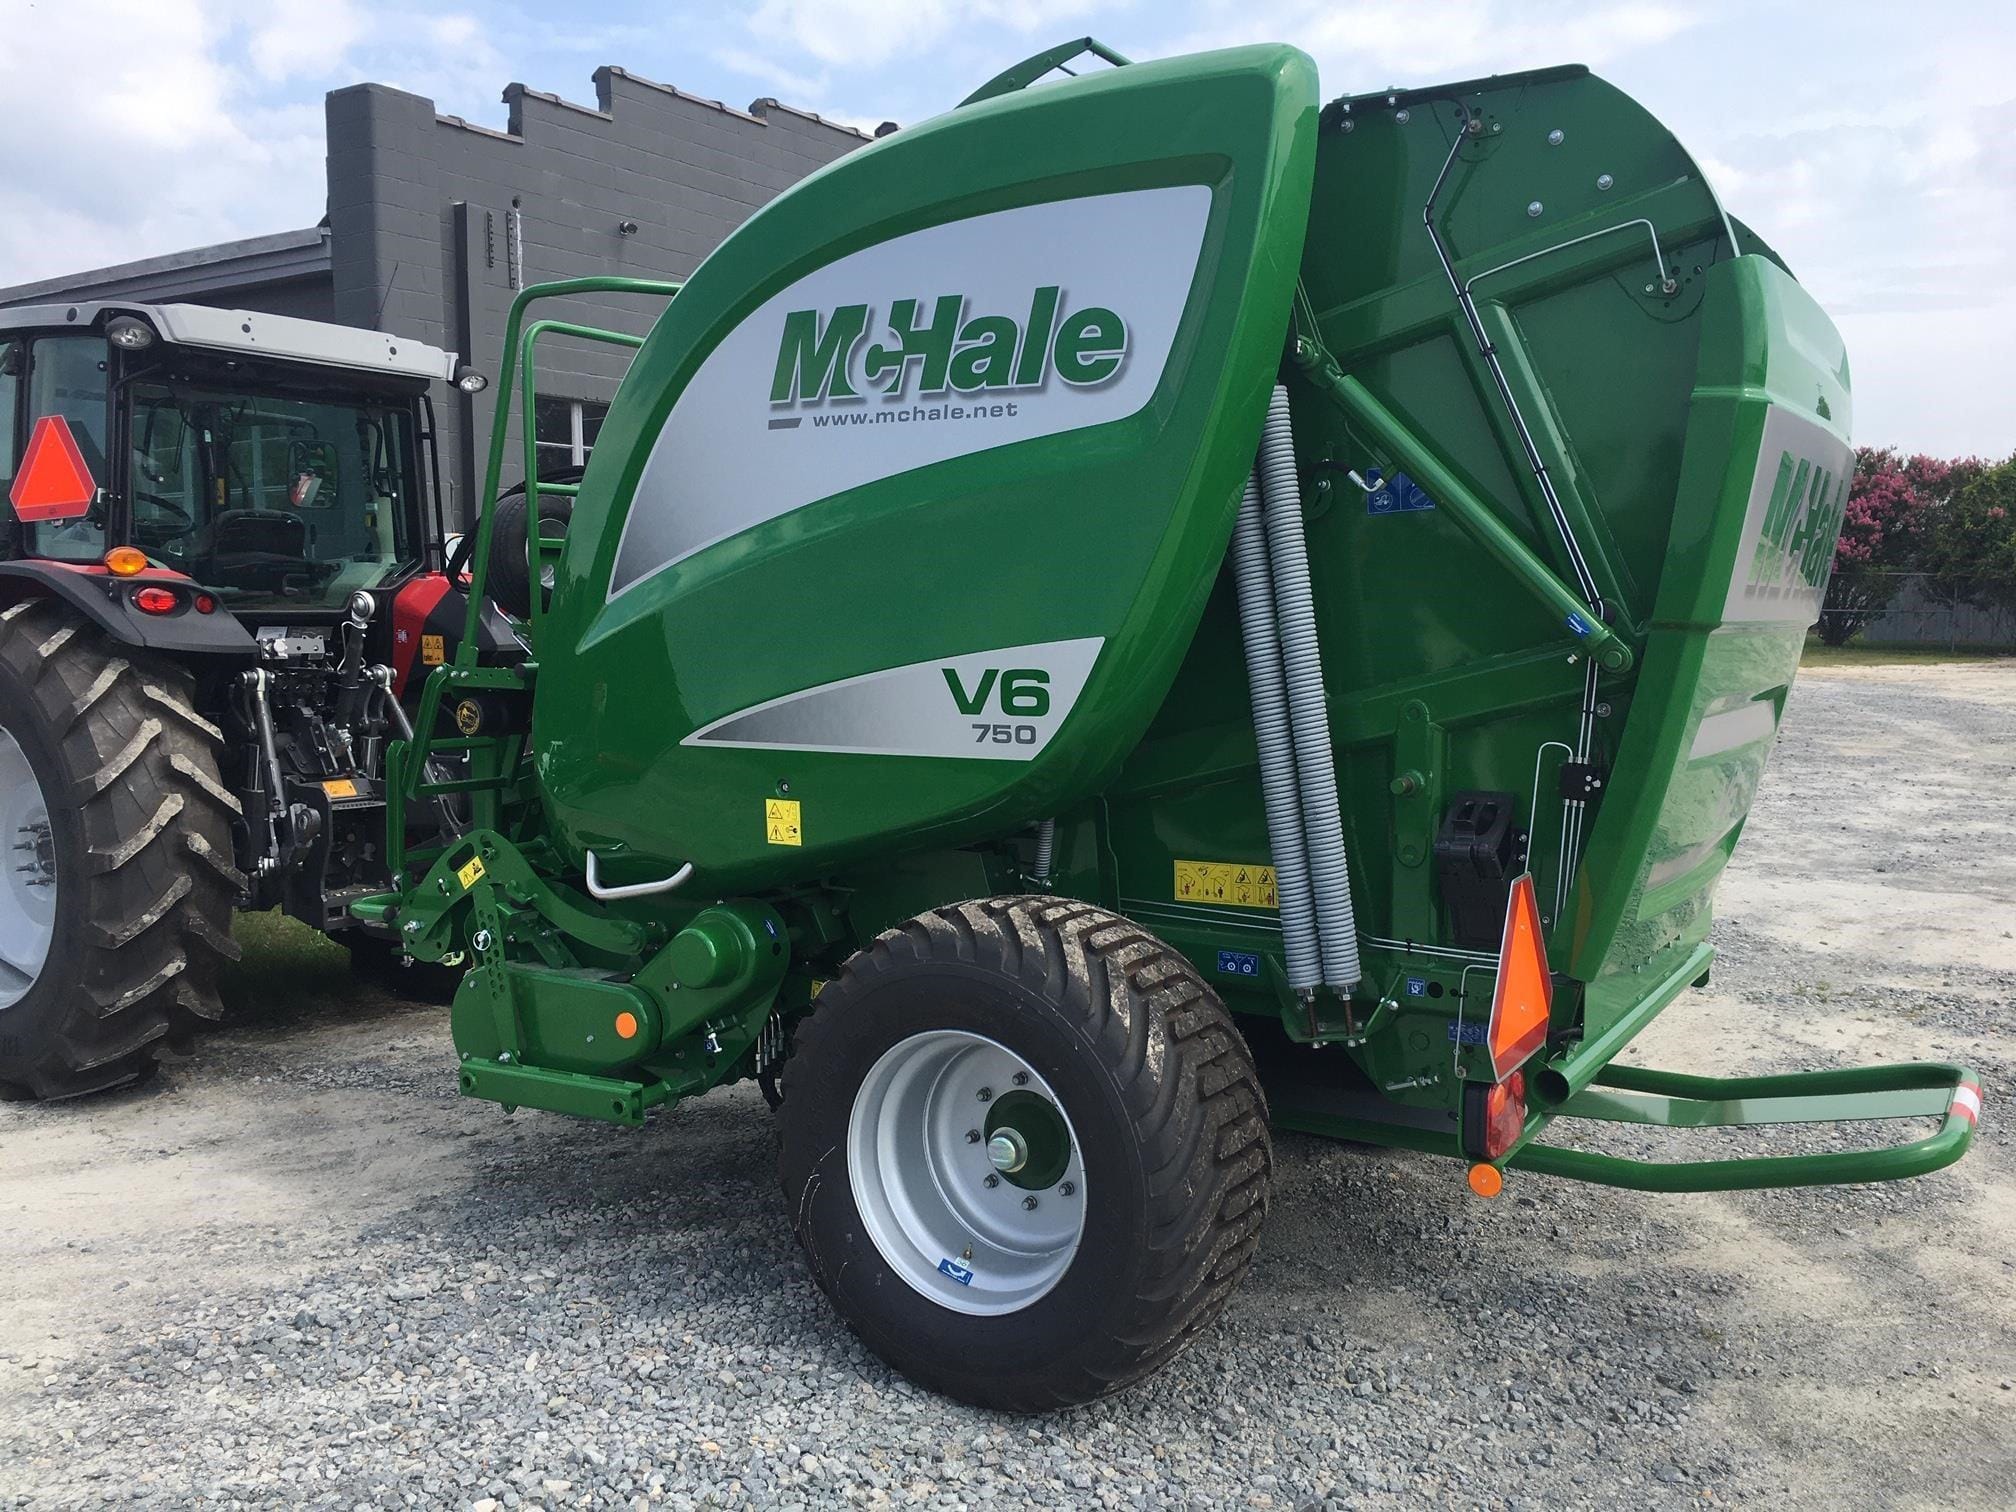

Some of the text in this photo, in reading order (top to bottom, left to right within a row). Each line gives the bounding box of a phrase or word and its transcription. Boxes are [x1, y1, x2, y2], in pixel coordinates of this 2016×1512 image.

[769, 285, 1126, 402] McHale
[813, 402, 1018, 427] www.mchale.net
[941, 668, 1050, 716] V6
[972, 723, 1037, 745] 750
